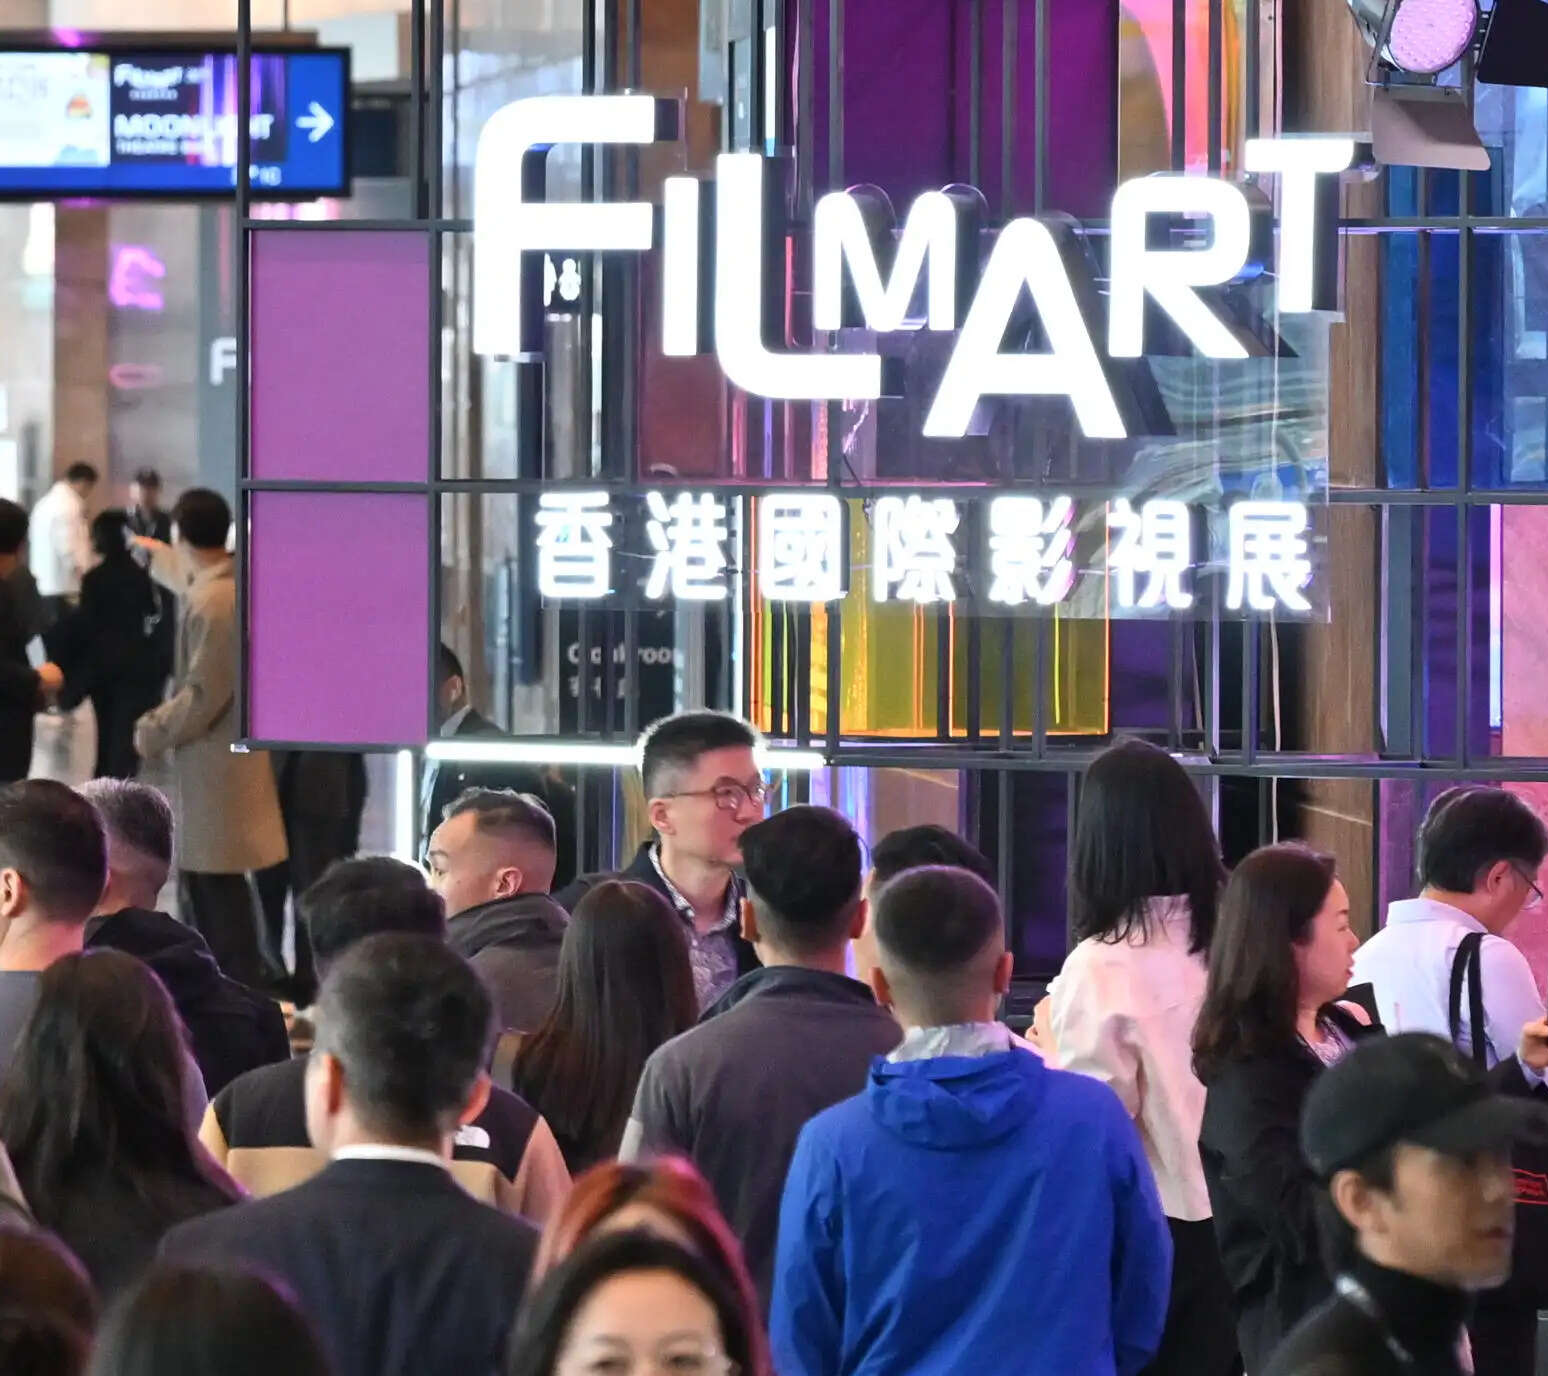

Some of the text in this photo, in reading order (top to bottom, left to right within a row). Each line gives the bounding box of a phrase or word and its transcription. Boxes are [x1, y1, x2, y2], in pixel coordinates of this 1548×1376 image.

[472, 94, 1356, 439] FILMART
[534, 490, 1312, 611] 香港國際影視展
